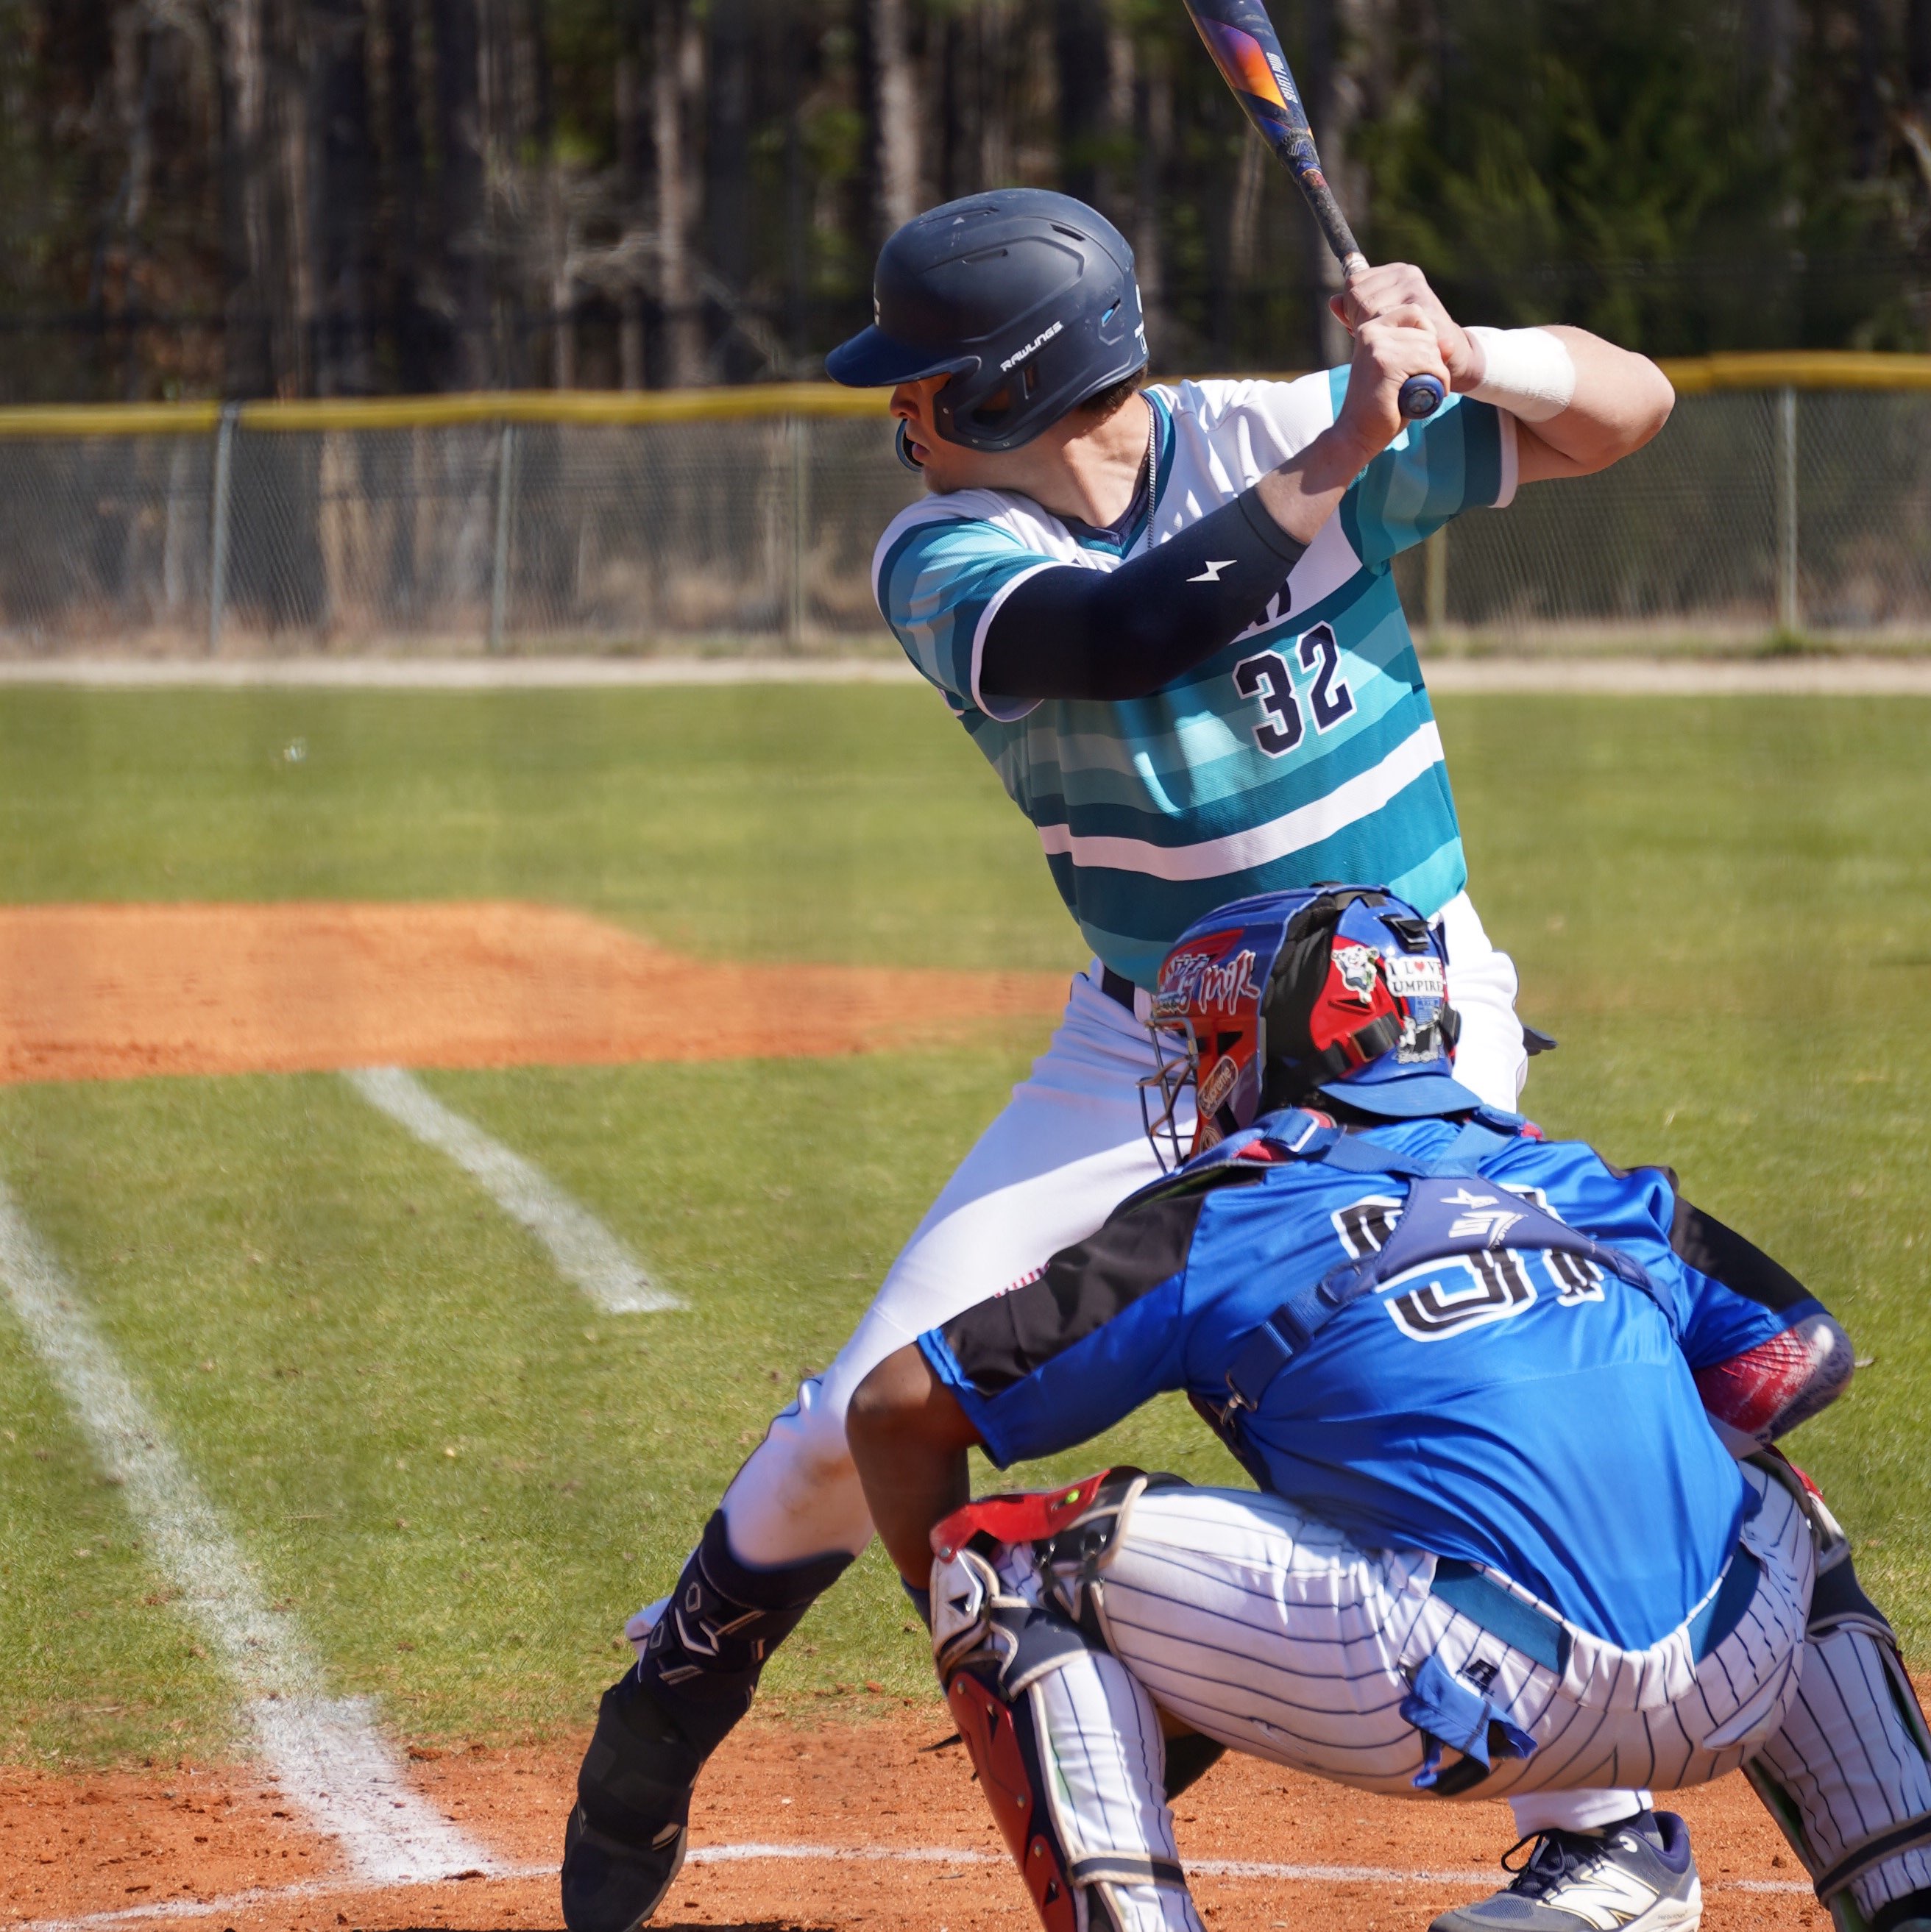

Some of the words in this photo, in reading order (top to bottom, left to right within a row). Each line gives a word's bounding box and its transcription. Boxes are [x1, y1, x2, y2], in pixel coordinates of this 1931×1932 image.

[1000, 321, 1064, 372] RAWLINGS
[1232, 620, 1358, 759] 32
[1201, 1065, 1232, 1110] Supreme
